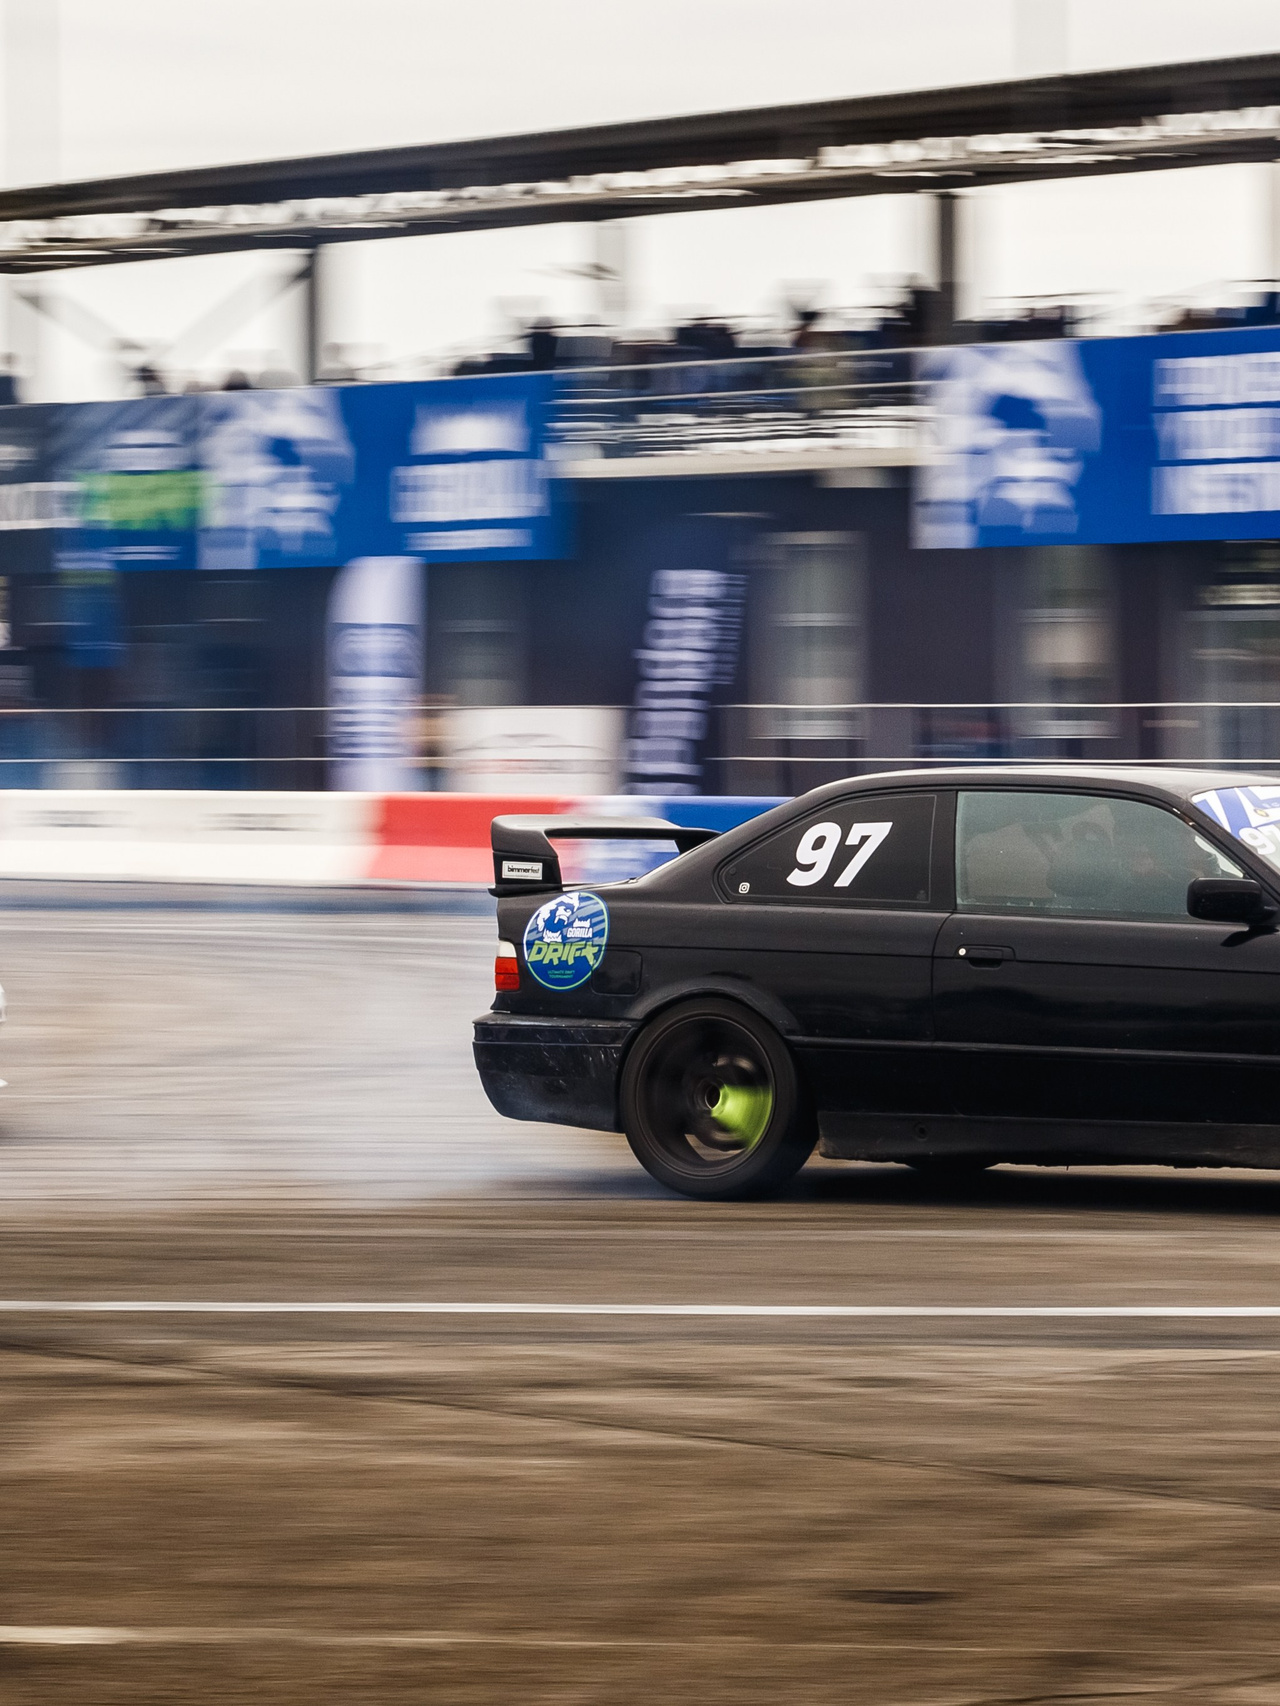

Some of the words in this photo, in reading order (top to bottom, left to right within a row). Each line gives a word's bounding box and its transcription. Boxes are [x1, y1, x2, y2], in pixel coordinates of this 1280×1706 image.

[786, 822, 893, 887] 97
[567, 927, 593, 938] GORILLA
[528, 940, 599, 967] DRIFT
